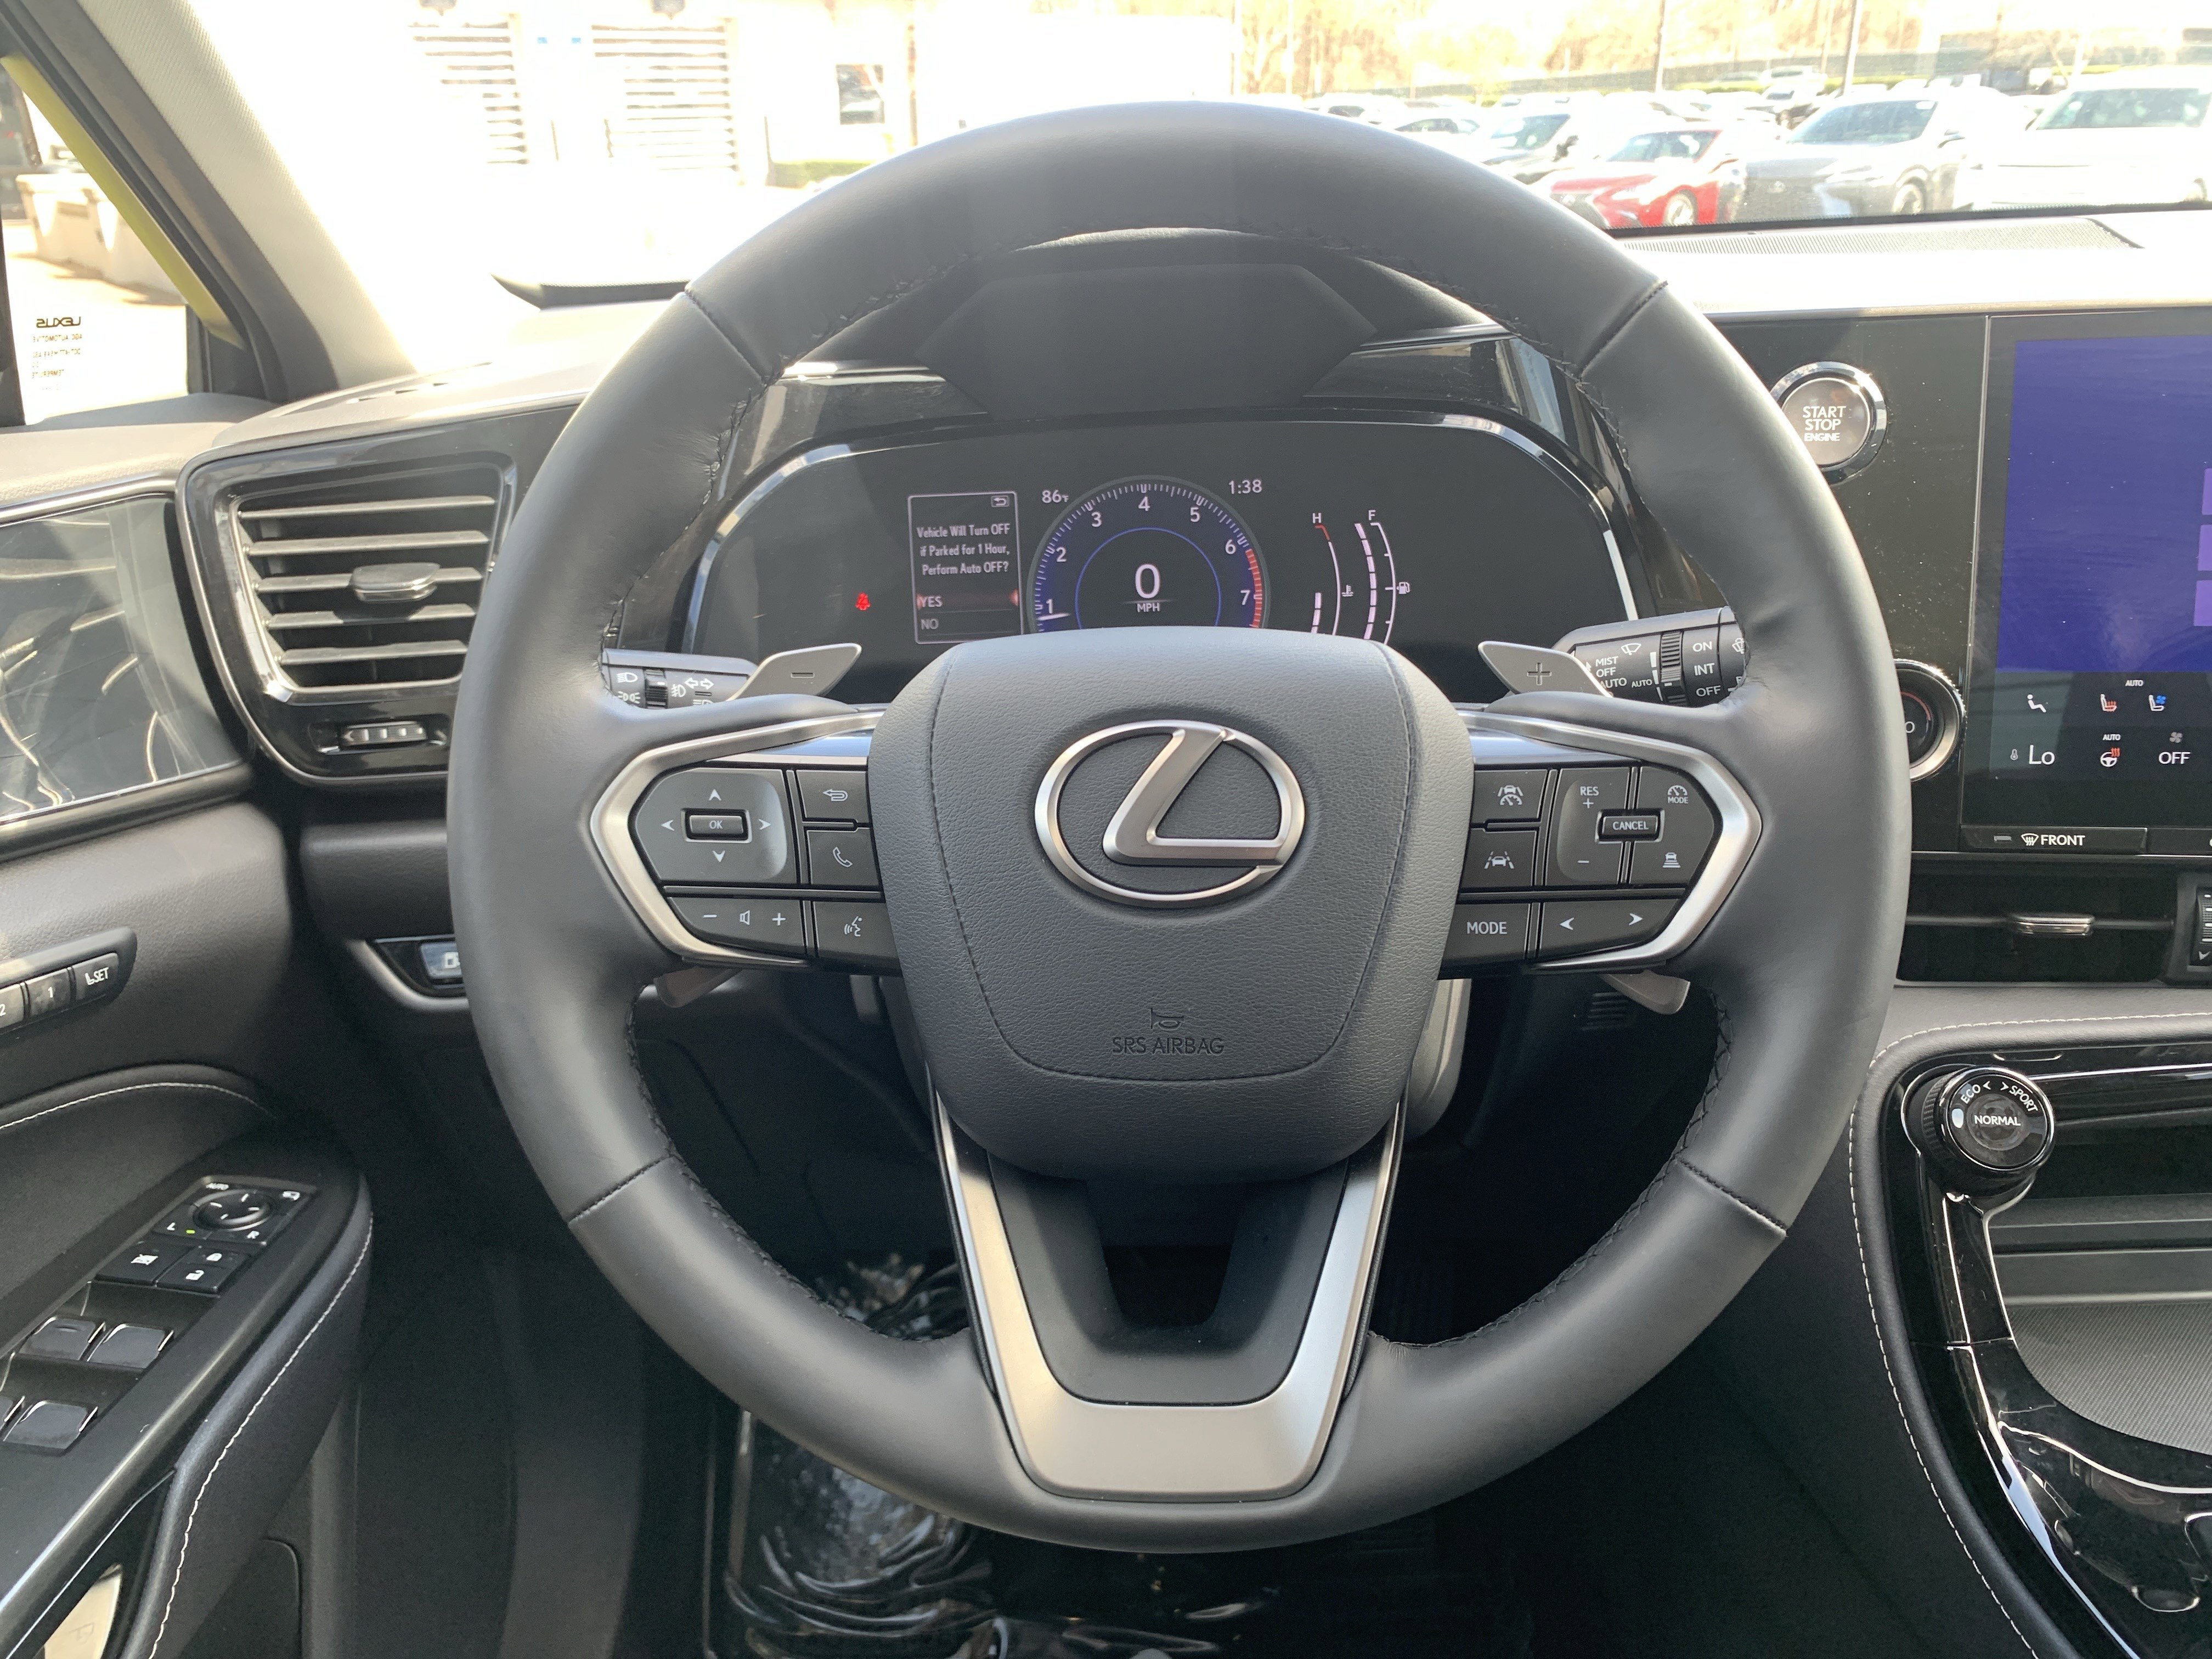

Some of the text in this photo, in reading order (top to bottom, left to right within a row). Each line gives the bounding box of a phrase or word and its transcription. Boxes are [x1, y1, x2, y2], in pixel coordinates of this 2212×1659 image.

[1803, 406, 1846, 419] START
[1805, 419, 1841, 431] STOP
[1804, 433, 1841, 441] ENGINE
[1228, 479, 1262, 495] 1:38
[1138, 496, 1150, 512] 4
[1091, 512, 1102, 528] 3
[1189, 506, 1201, 522] 5
[1312, 513, 1322, 524] H
[1368, 510, 1376, 521] F
[917, 523, 1011, 538] Vehicle Will Turn OFF
[920, 545, 927, 557] if
[929, 544, 960, 557] Parked
[961, 544, 976, 555] for
[978, 543, 983, 555] 1
[1225, 539, 1236, 554] 6
[1056, 547, 1067, 562] 2
[922, 561, 1009, 575] Perform Auto OFF?
[1135, 563, 1161, 599] 0
[921, 596, 943, 608] YES
[1240, 590, 1250, 606] 7
[1046, 599, 1053, 614] 1
[1137, 602, 1161, 613] MPH
[921, 619, 939, 630] NO
[1692, 641, 1712, 652] ON
[1595, 656, 1619, 667] MIST
[1596, 667, 1616, 678] OFF
[1694, 663, 1715, 676] INT
[1631, 679, 1653, 688] AUTO
[1696, 685, 1721, 697] OFF
[2158, 751, 2191, 765] OFF
[1580, 786, 1599, 796] RES
[1667, 796, 1689, 804] MODE
[709, 820, 723, 830] OK
[1612, 821, 1649, 831] CANCEL
[2040, 834, 2086, 846] FRONT
[1466, 921, 1508, 935] MODE
[47, 986, 54, 998] 1
[0, 1003, 7, 1016] 2
[1113, 1036, 1224, 1054] SRS AIRBAG
[1960, 1084, 1981, 1104] ECO
[2008, 1085, 2038, 1113] SPORT
[1974, 1115, 2021, 1126] NORMAL
